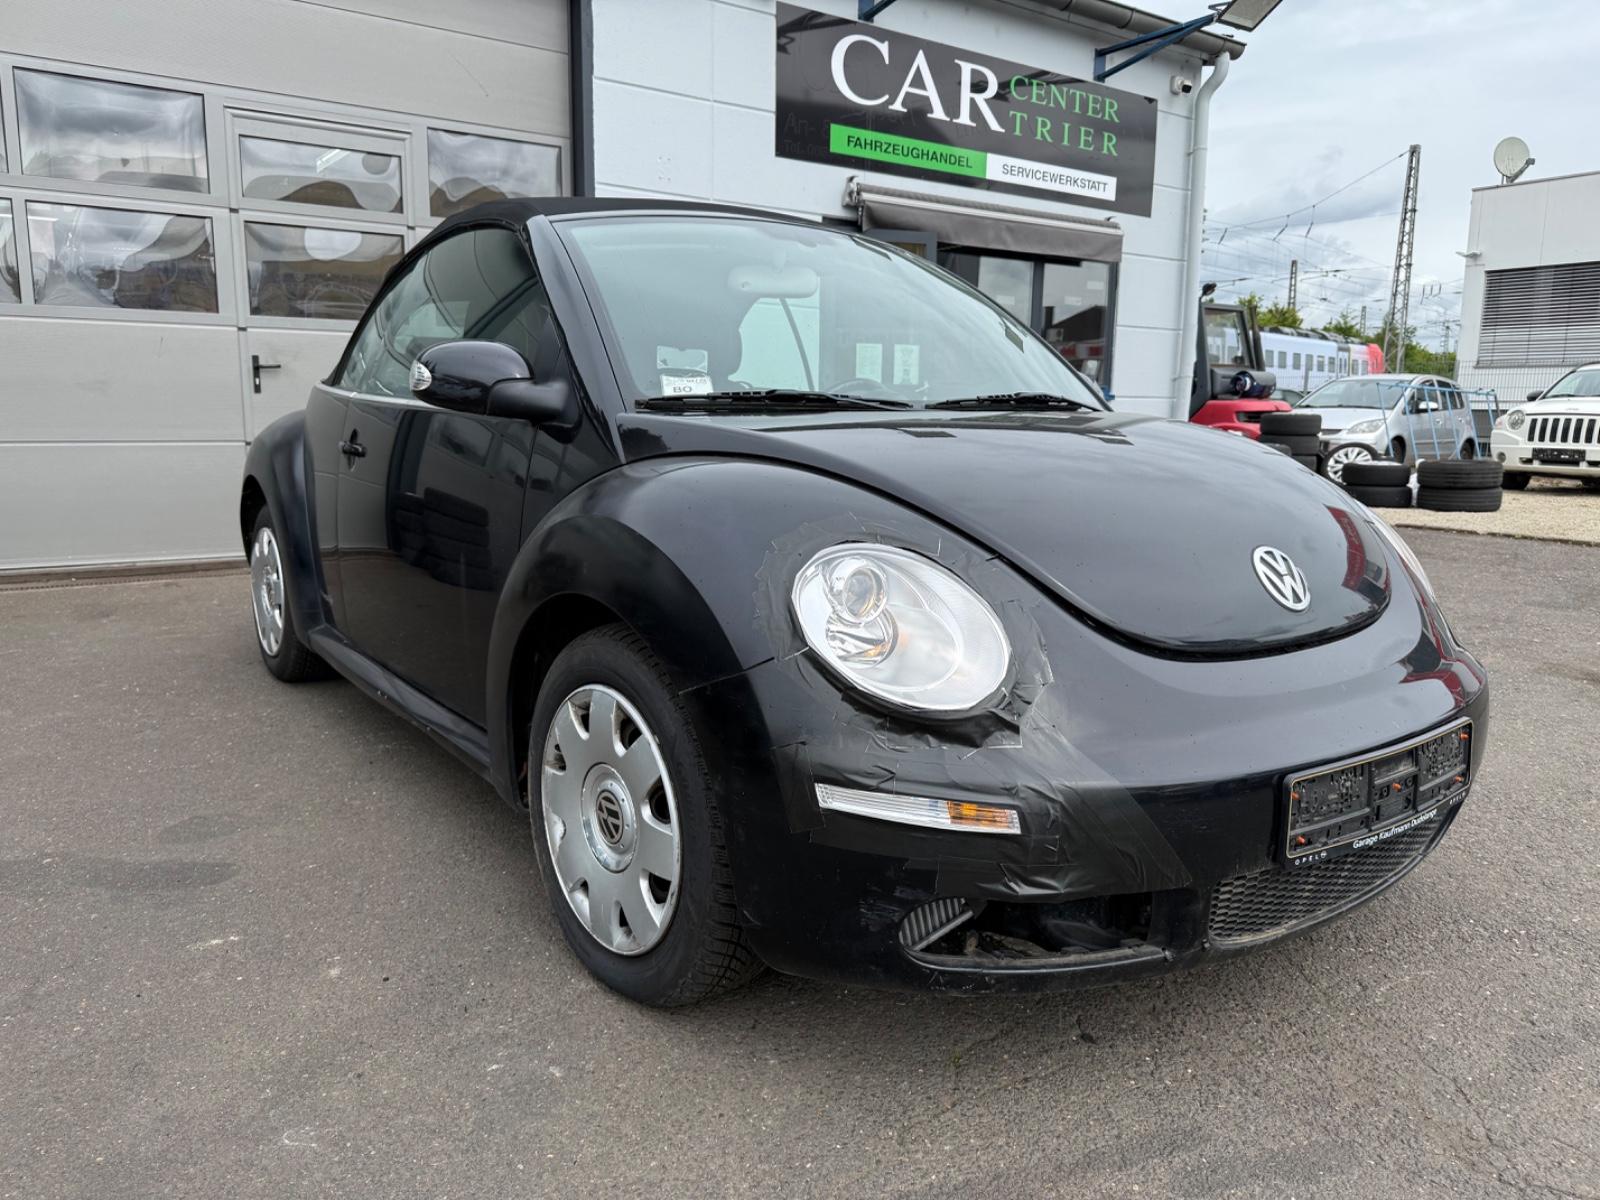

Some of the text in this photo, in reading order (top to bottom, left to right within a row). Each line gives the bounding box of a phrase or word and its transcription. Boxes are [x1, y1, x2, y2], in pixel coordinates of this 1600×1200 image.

[831, 34, 1005, 132] CAR
[1010, 75, 1120, 123] CENTER
[846, 135, 973, 169] FAHRZEUGHANDEL
[1009, 110, 1118, 156] TRIER
[1002, 164, 1107, 193] SERVICEWERKSTATT
[1253, 546, 1310, 611] VW
[1353, 835, 1378, 849] Garage
